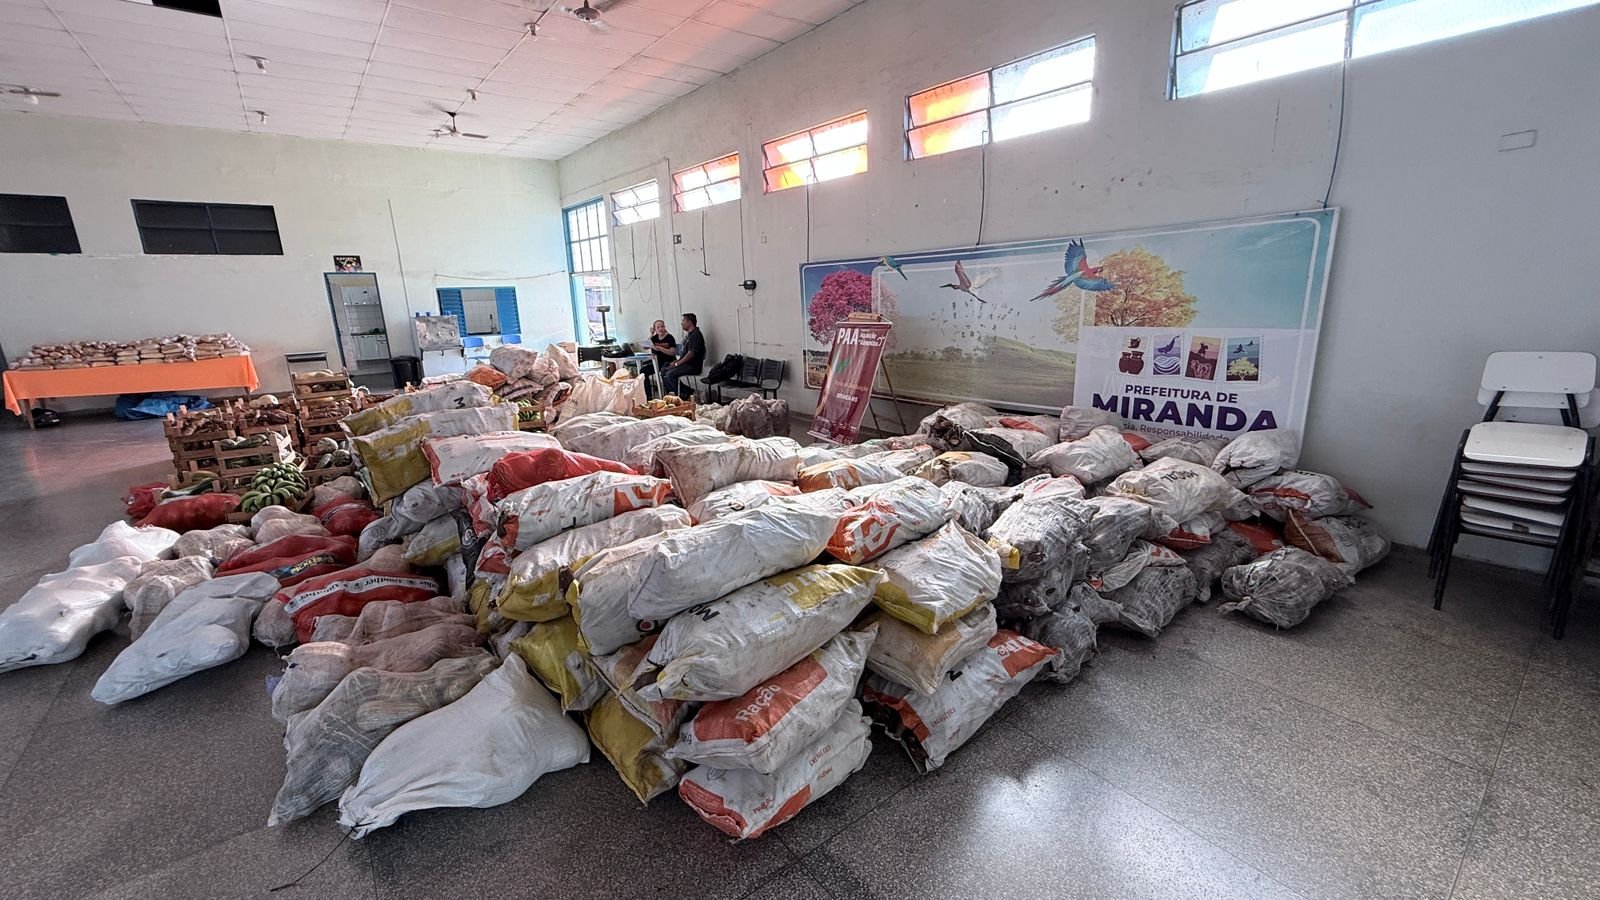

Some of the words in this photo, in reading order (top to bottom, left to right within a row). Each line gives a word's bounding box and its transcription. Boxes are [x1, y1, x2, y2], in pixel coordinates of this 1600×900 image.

[836, 327, 859, 345] PAA
[1125, 384, 1212, 401] PREFEITURA
[1216, 391, 1238, 404] DE
[1092, 393, 1278, 432] MIRANDA
[735, 684, 781, 722] Ração
